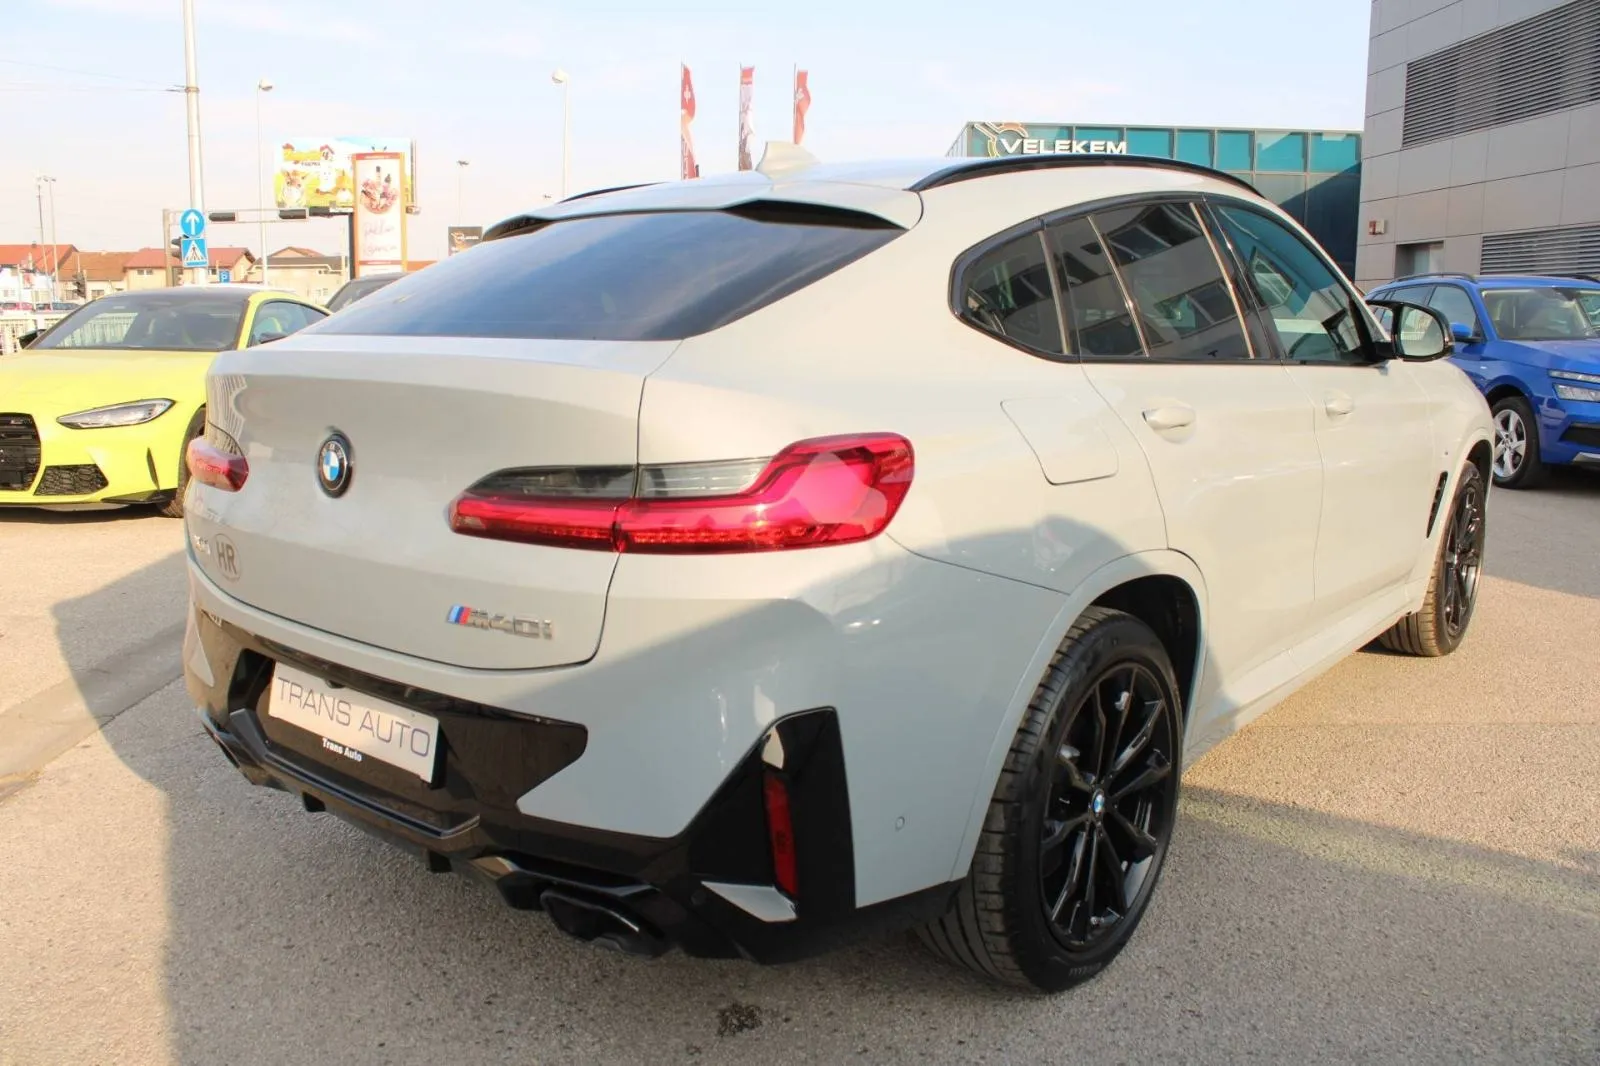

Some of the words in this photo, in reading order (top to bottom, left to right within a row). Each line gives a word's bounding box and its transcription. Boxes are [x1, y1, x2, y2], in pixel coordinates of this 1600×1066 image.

[1001, 138, 1127, 155] VELEKEM
[216, 541, 238, 575] HR
[277, 676, 351, 727] TRANS
[358, 710, 430, 758] AUTO
[322, 737, 344, 755] Trans
[343, 746, 363, 763] Auto
